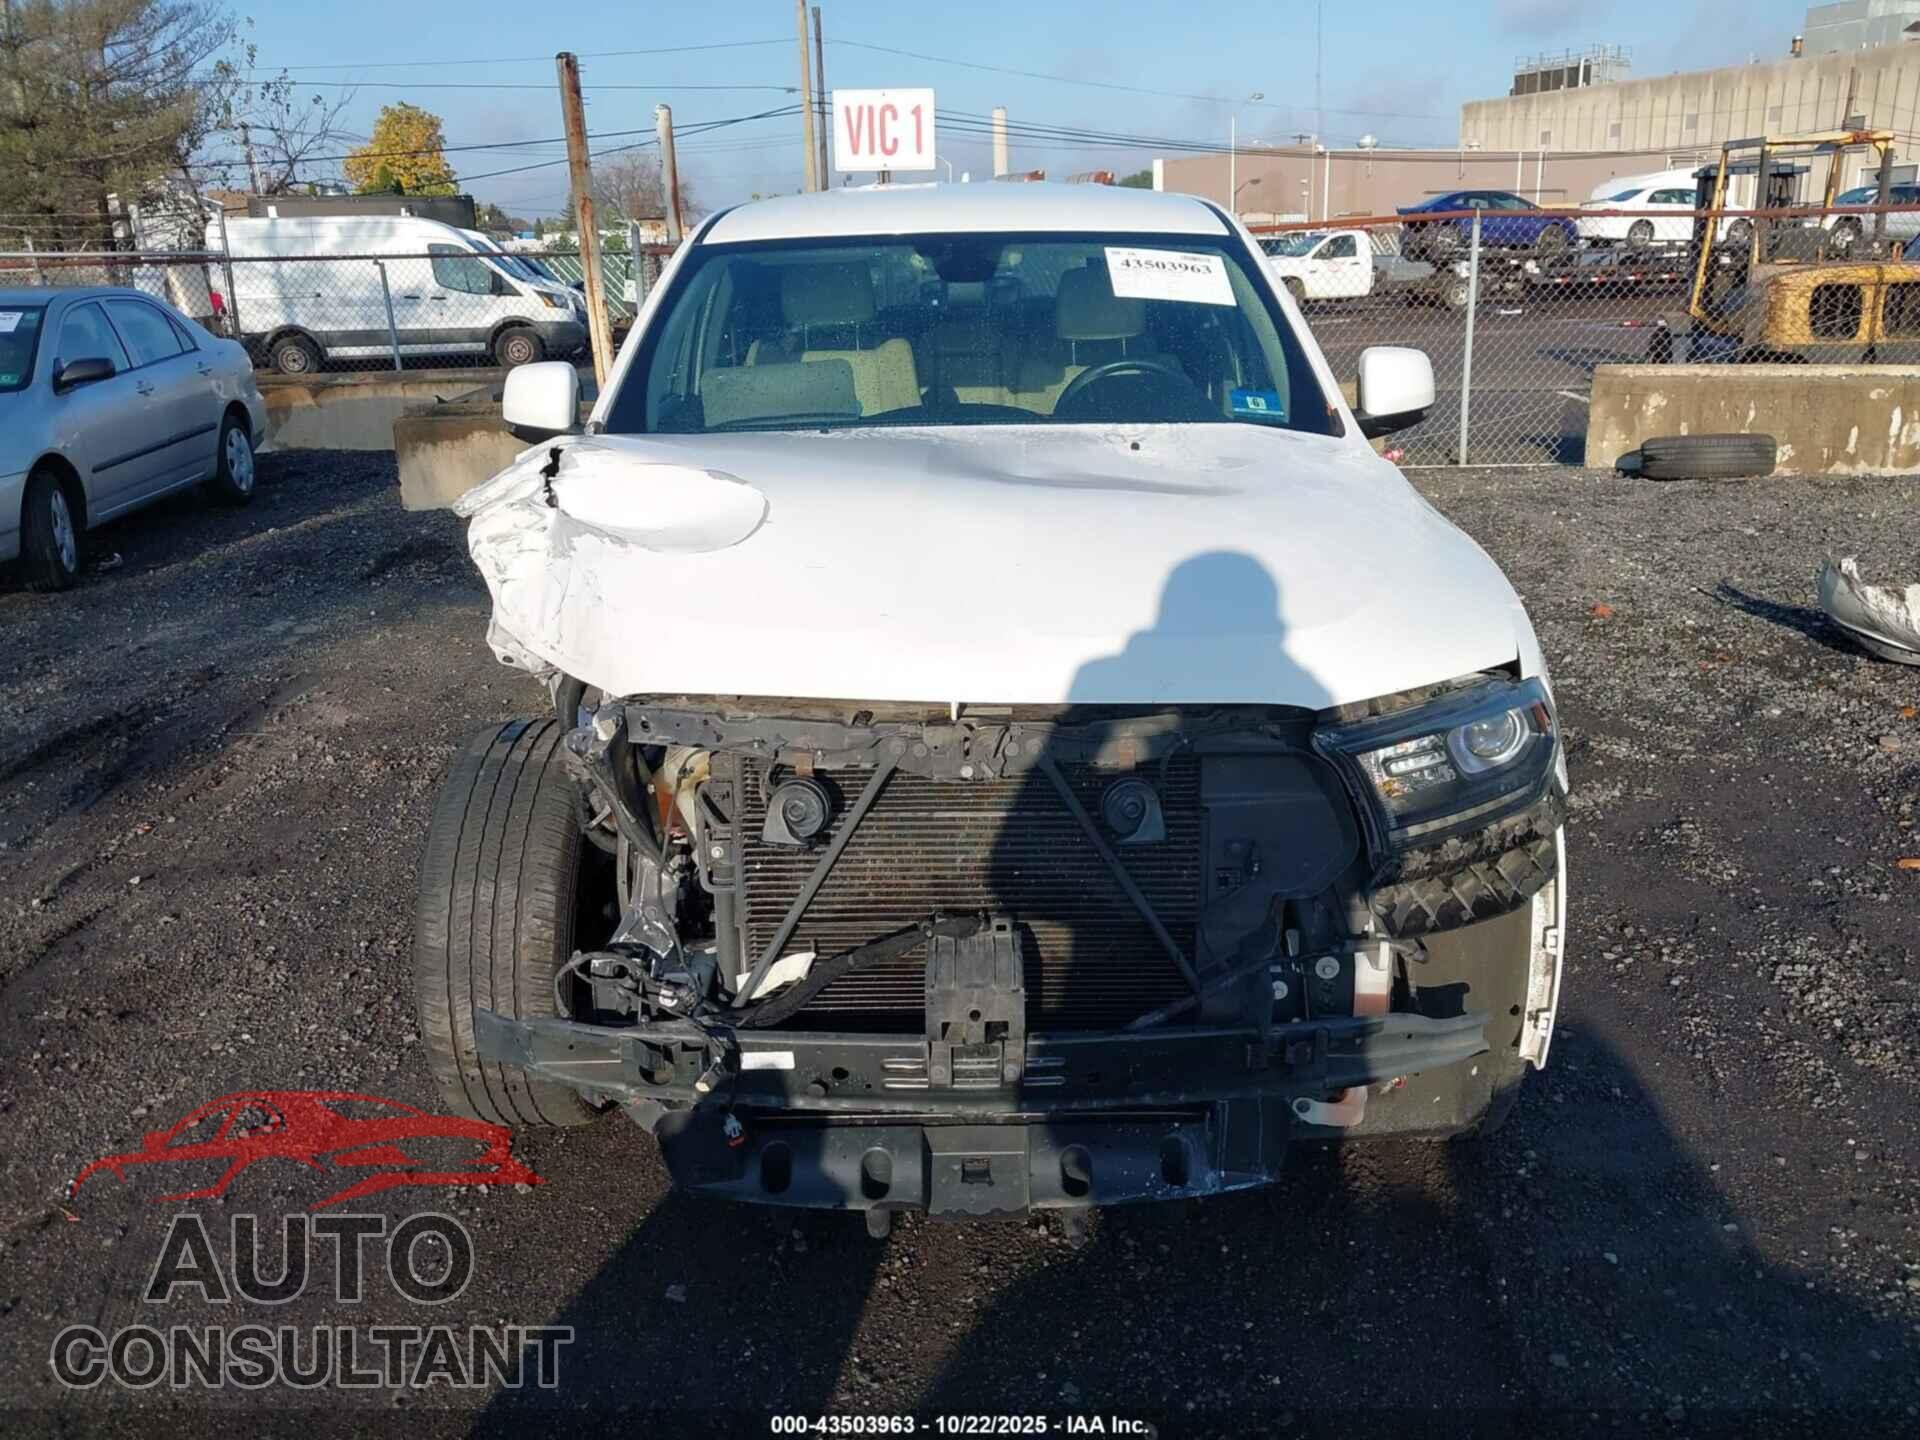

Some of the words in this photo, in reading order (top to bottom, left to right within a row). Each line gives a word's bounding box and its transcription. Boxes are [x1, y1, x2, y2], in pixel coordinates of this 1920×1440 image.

[845, 104, 898, 156] VIC
[911, 104, 923, 155] 1
[1120, 258, 1213, 275] 43503963
